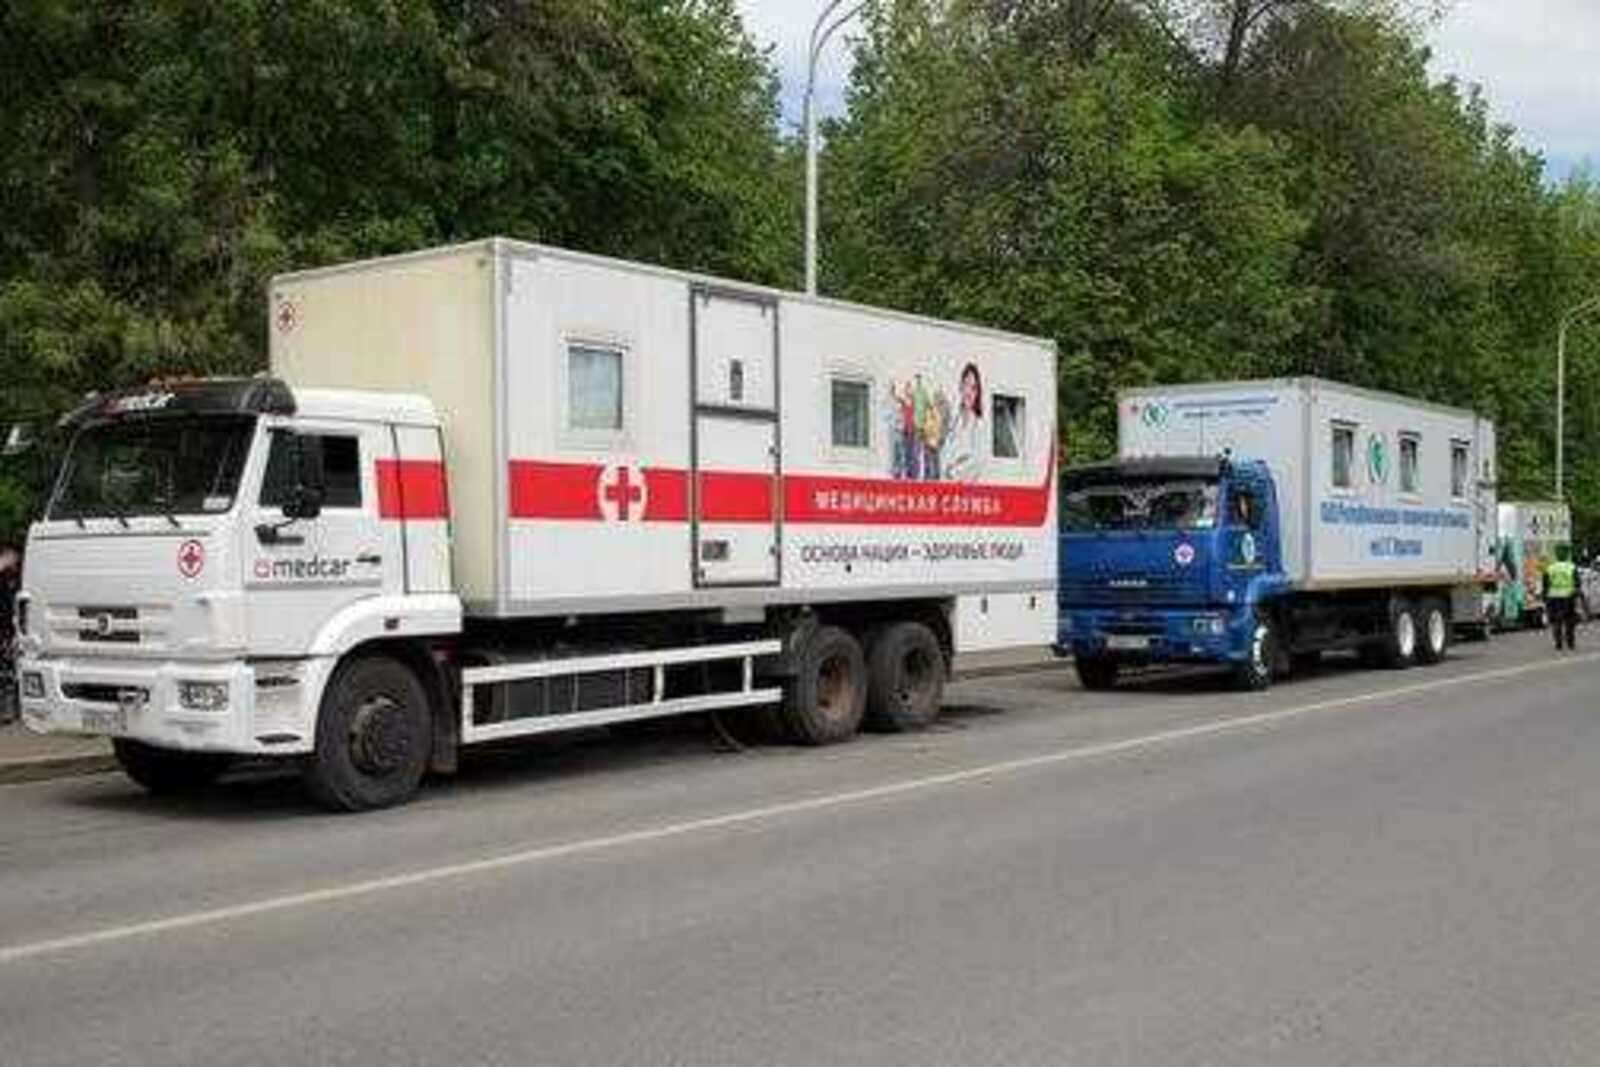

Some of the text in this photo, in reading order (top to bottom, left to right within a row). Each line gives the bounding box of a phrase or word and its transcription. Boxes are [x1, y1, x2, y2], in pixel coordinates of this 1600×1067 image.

[814, 490, 1002, 515] МЕДИЦИНСКАЯ СЛУЖБА
[272, 554, 351, 578] medcar
[800, 545, 857, 563] ОСНОВА
